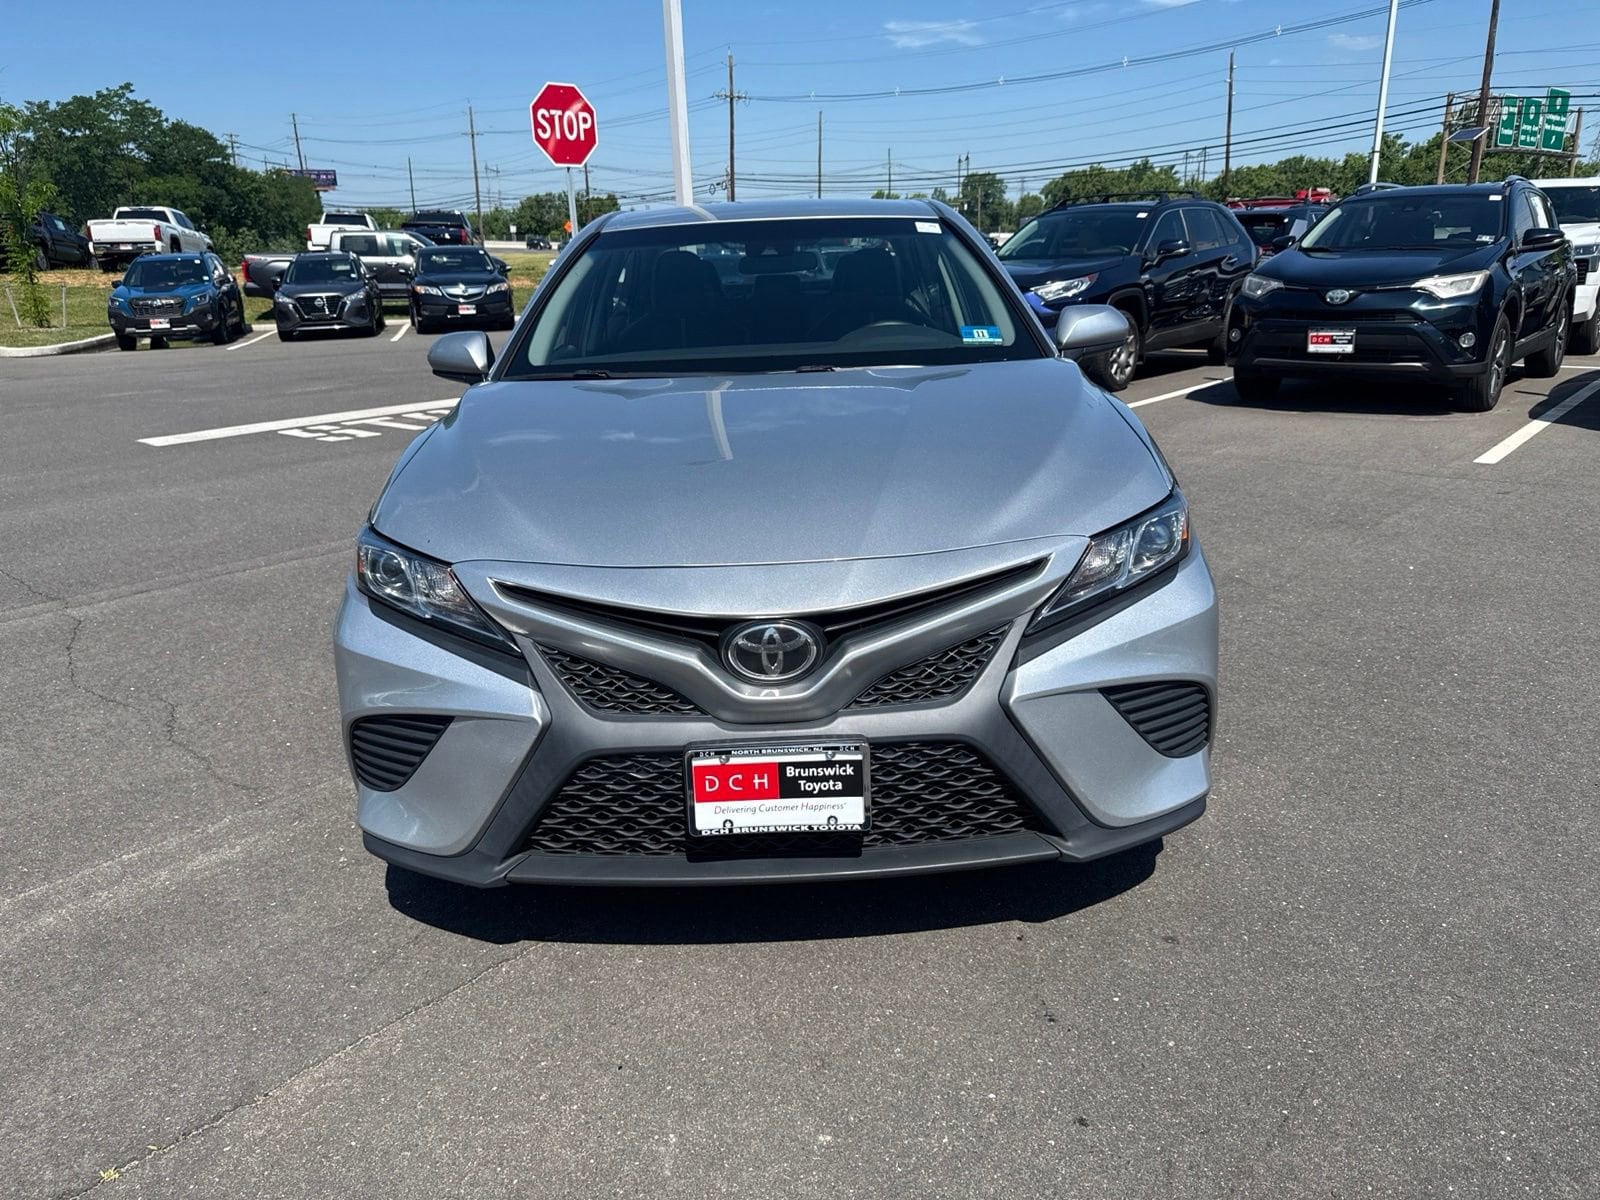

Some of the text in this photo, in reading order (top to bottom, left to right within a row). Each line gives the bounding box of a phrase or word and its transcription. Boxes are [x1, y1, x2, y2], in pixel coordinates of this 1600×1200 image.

[537, 108, 592, 142] STOP
[277, 409, 452, 442] STO
[786, 763, 854, 778] Brunswick
[798, 779, 843, 794] Toyota
[714, 805, 757, 816] Delivering
[758, 803, 799, 813] Customer
[701, 823, 862, 836] DCH BRUNSWICK TOYOTA
